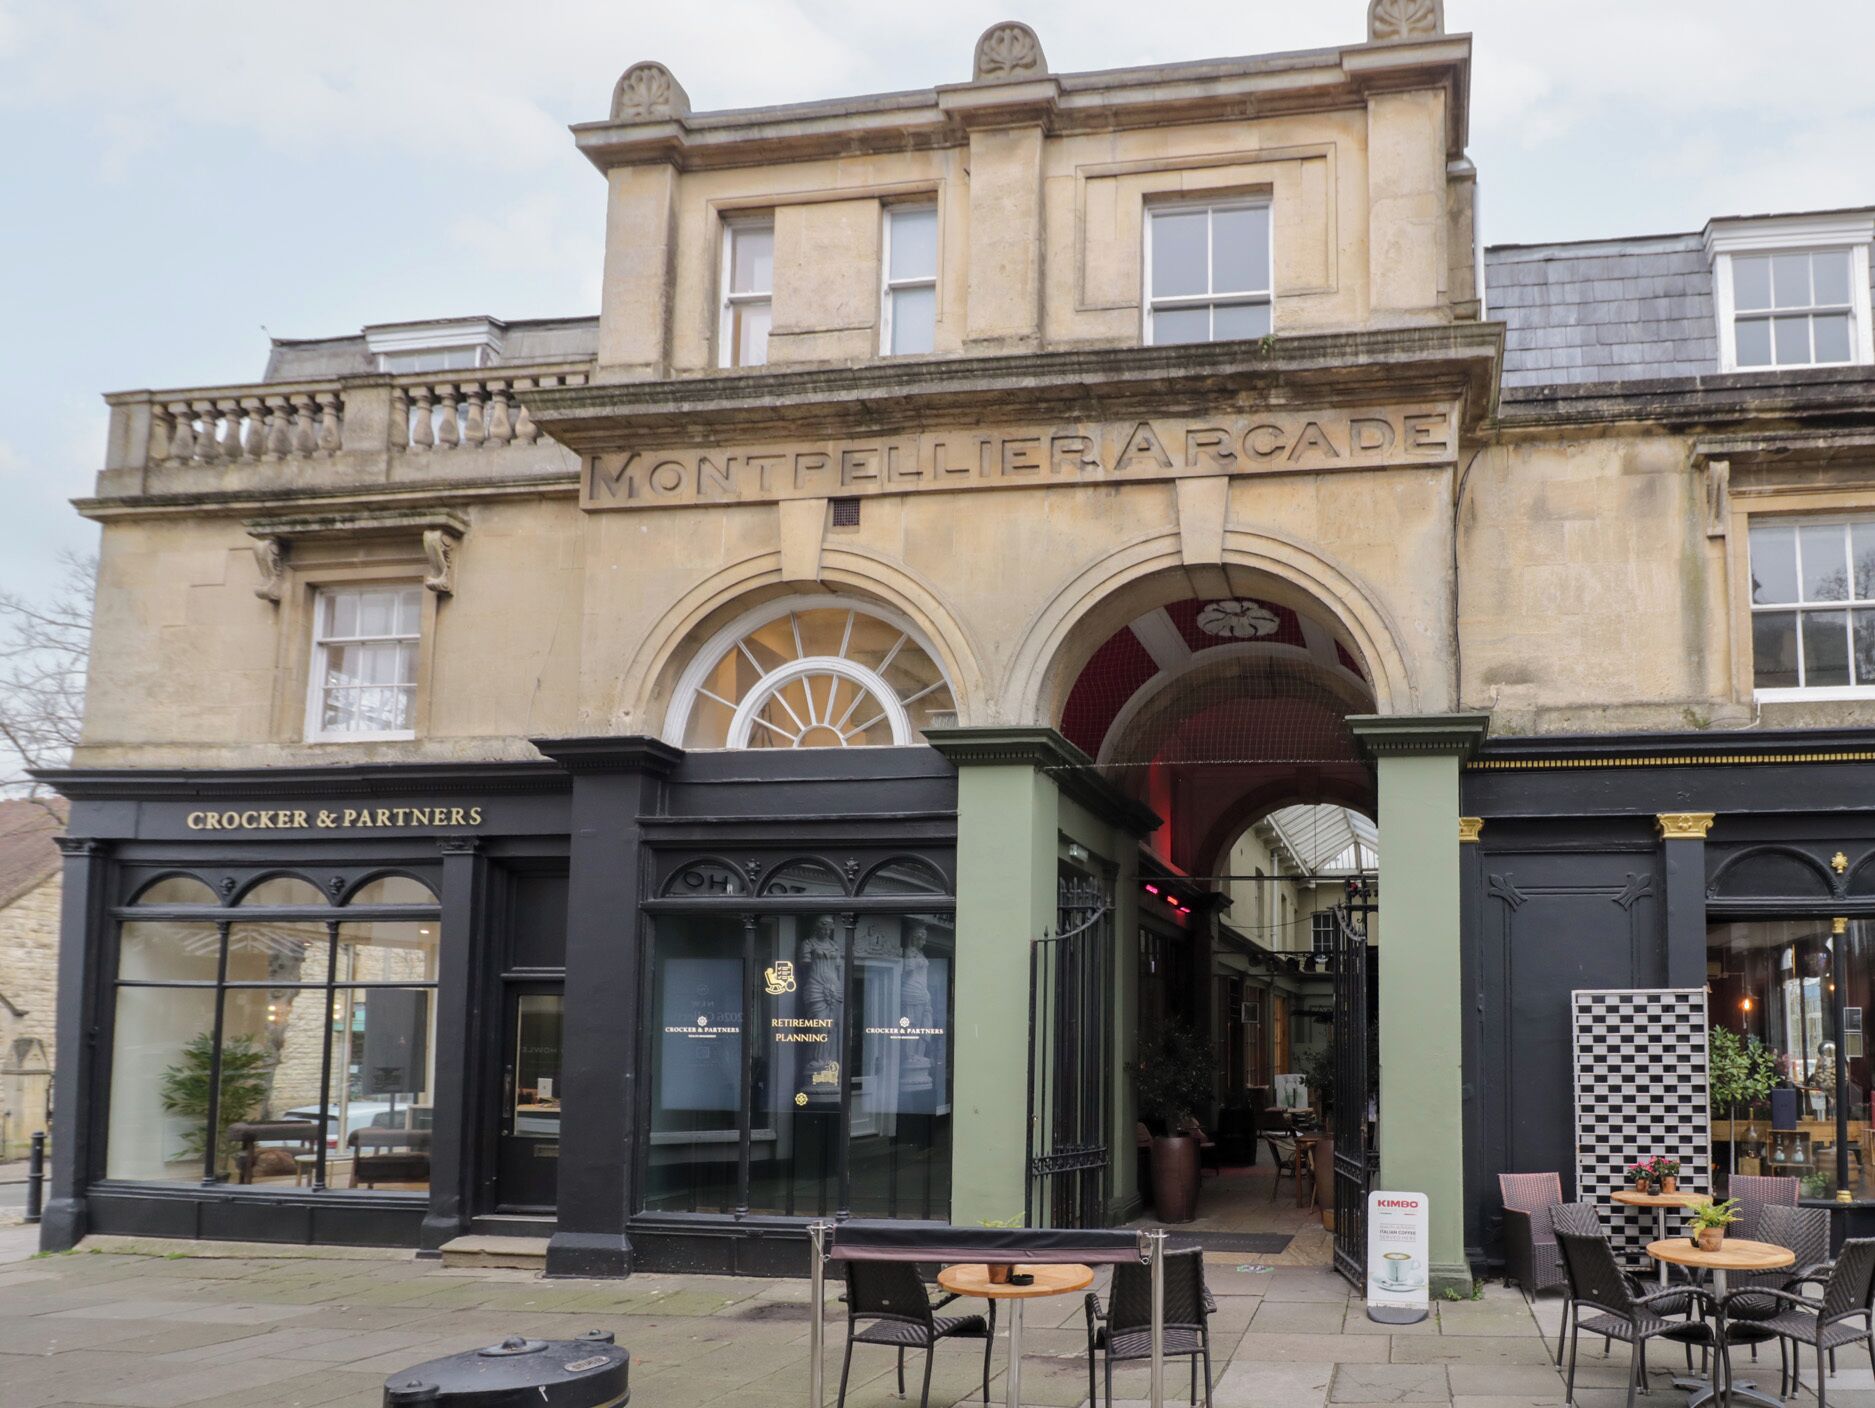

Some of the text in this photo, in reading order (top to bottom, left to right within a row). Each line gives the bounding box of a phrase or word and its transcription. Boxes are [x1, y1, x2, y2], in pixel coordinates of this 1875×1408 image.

[589, 412, 1449, 501] MONTPELLIER ARCADE
[186, 806, 483, 830] CROCKER & PARTNERS
[771, 1018, 833, 1028] RETIREMENT
[775, 1033, 828, 1042] PLANNING
[1377, 1199, 1418, 1208] KIMBO
